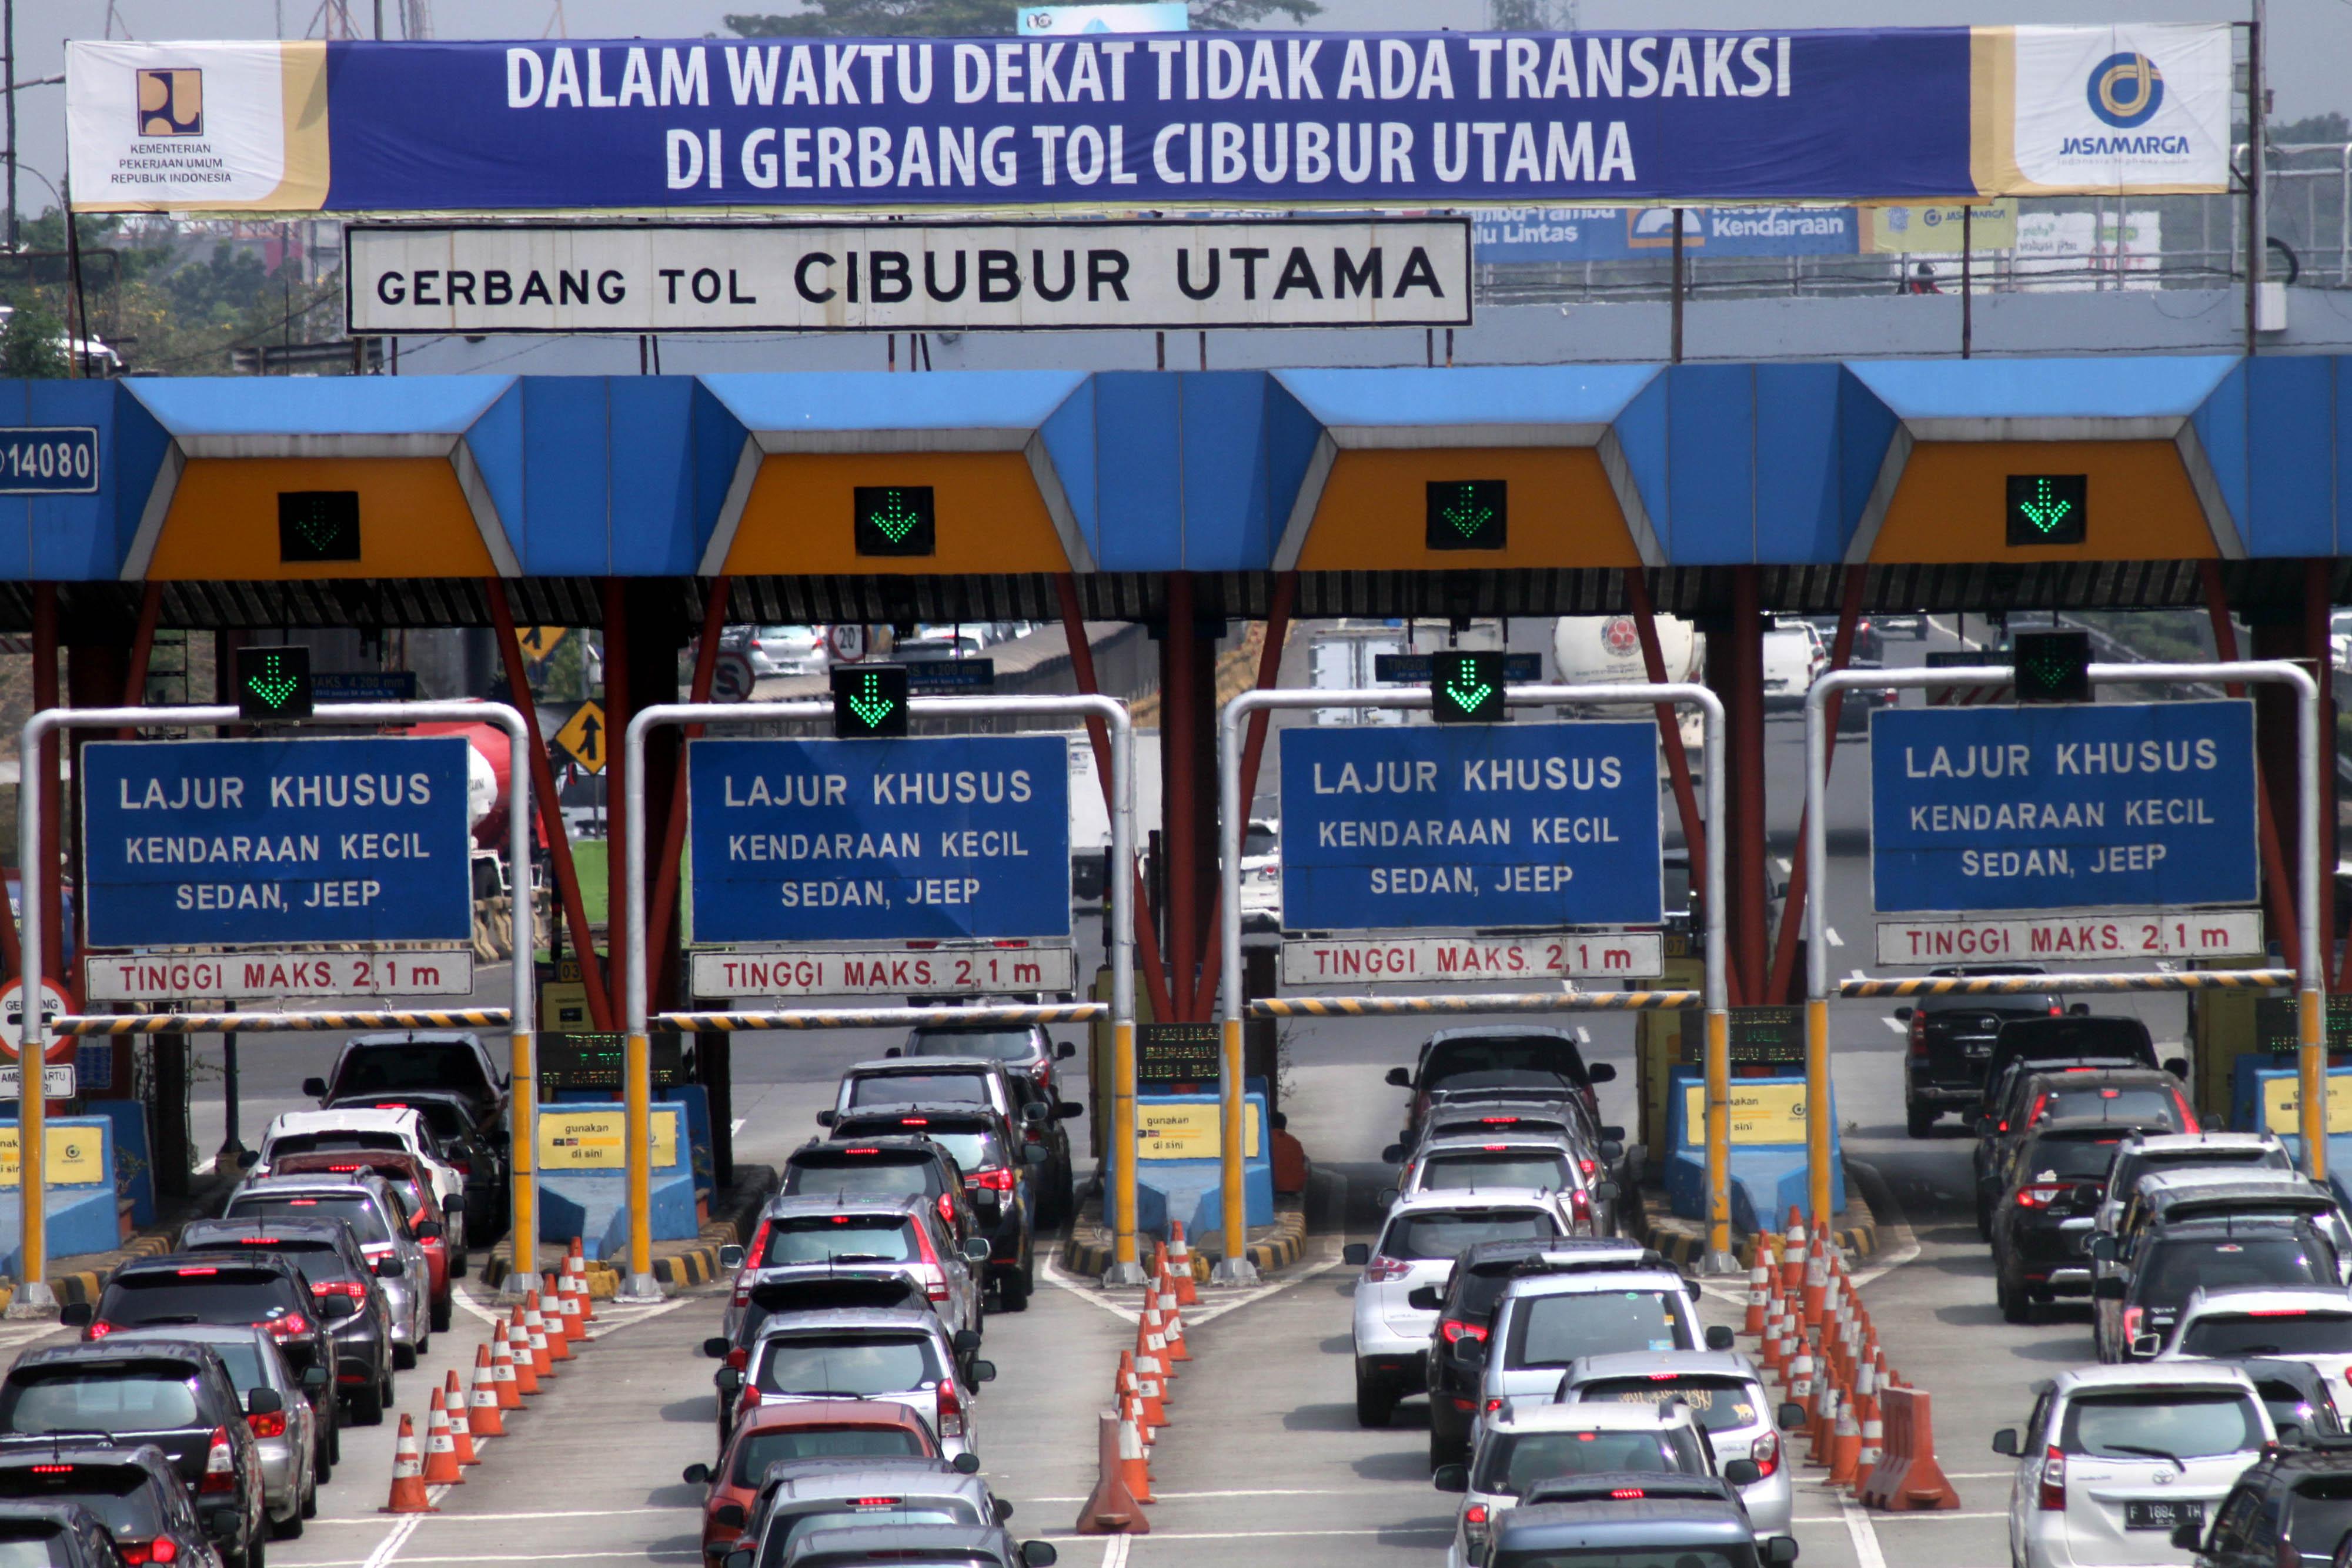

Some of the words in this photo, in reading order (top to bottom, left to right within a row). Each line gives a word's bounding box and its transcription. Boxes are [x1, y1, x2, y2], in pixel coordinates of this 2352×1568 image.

[506, 46, 710, 108] DALAM
[724, 44, 933, 105] WAKTU
[953, 41, 1134, 103] DEKAT
[1148, 38, 1324, 101] TIDAK
[1337, 38, 1454, 99] ADA
[1468, 36, 1790, 99] TRANSAKSI
[131, 143, 211, 154] KEMENTERIAN
[666, 129, 722, 189] DI
[741, 125, 1017, 189] GERBANG
[1032, 125, 1137, 186] TOL
[1152, 122, 1415, 183] CIBUBUR
[1434, 121, 1636, 182] UTAMA
[2060, 136, 2190, 155] JASAMARGA
[111, 173, 167, 183] REPUBLIK
[170, 173, 232, 183] INDONESIA
[119, 159, 183, 169] PEKERJAAN
[186, 158, 223, 168] UMUM
[1504, 223, 1578, 243] Lintas
[1712, 216, 1844, 237] Kendaraan
[377, 269, 626, 306] GERBANG
[659, 268, 756, 304] TOL
[794, 249, 1130, 304] CIBUBUR
[1177, 246, 1445, 300] UTAMA
[8, 443, 89, 478] 14080
[1906, 744, 2030, 778] LAJUR
[2056, 738, 2217, 775] KHUSUS
[725, 774, 847, 807] LAJUR
[874, 770, 1031, 805] KHUSUS
[1314, 761, 1437, 794] LAJUR
[1464, 756, 1622, 791] KHUSUS
[120, 777, 244, 810] LAJUR
[270, 773, 430, 807] KHUSUS
[1911, 802, 2104, 831] KENDARAAN
[2126, 798, 2214, 826] KECIL
[729, 832, 920, 860] KENDARAAN
[942, 831, 1028, 857] KECIL
[1319, 818, 1511, 847] KENDARAAN
[1532, 817, 1619, 844] KECIL
[126, 835, 319, 863] KENDARAAN
[340, 833, 430, 860] KECIL
[1962, 849, 2074, 877] SEDAN,
[2090, 844, 2167, 873] JEEP
[781, 879, 890, 910] SEDAN,
[906, 878, 980, 904] JEEP
[1370, 867, 1479, 897] SEDAN,
[1495, 865, 1573, 892] JEEP
[176, 883, 288, 913] SEDAN,
[303, 880, 380, 907] JEEP
[1906, 928, 2010, 955] TINGGI
[2032, 924, 2125, 953] MAKS.
[2201, 928, 2229, 948] m
[723, 961, 823, 988] TINGGI
[844, 959, 937, 987] MAKS.
[1013, 963, 1041, 983] m
[1313, 947, 1415, 975] TINGGI
[1437, 947, 1529, 972] MAKS.
[1603, 950, 1632, 969] m
[119, 964, 222, 992] TINGGI
[244, 961, 337, 988] MAKS.
[412, 967, 440, 986] m
[5, 999, 58, 1011] GENG
[565, 1124, 609, 1135] gunakan
[1147, 1115, 1190, 1127] gunakan
[1734, 1122, 1752, 1131] sini
[571, 1149, 582, 1159] di
[584, 1149, 603, 1159] sini
[1152, 1140, 1162, 1150] di
[1165, 1140, 1184, 1150] sini
[2129, 1506, 2139, 1520] F
